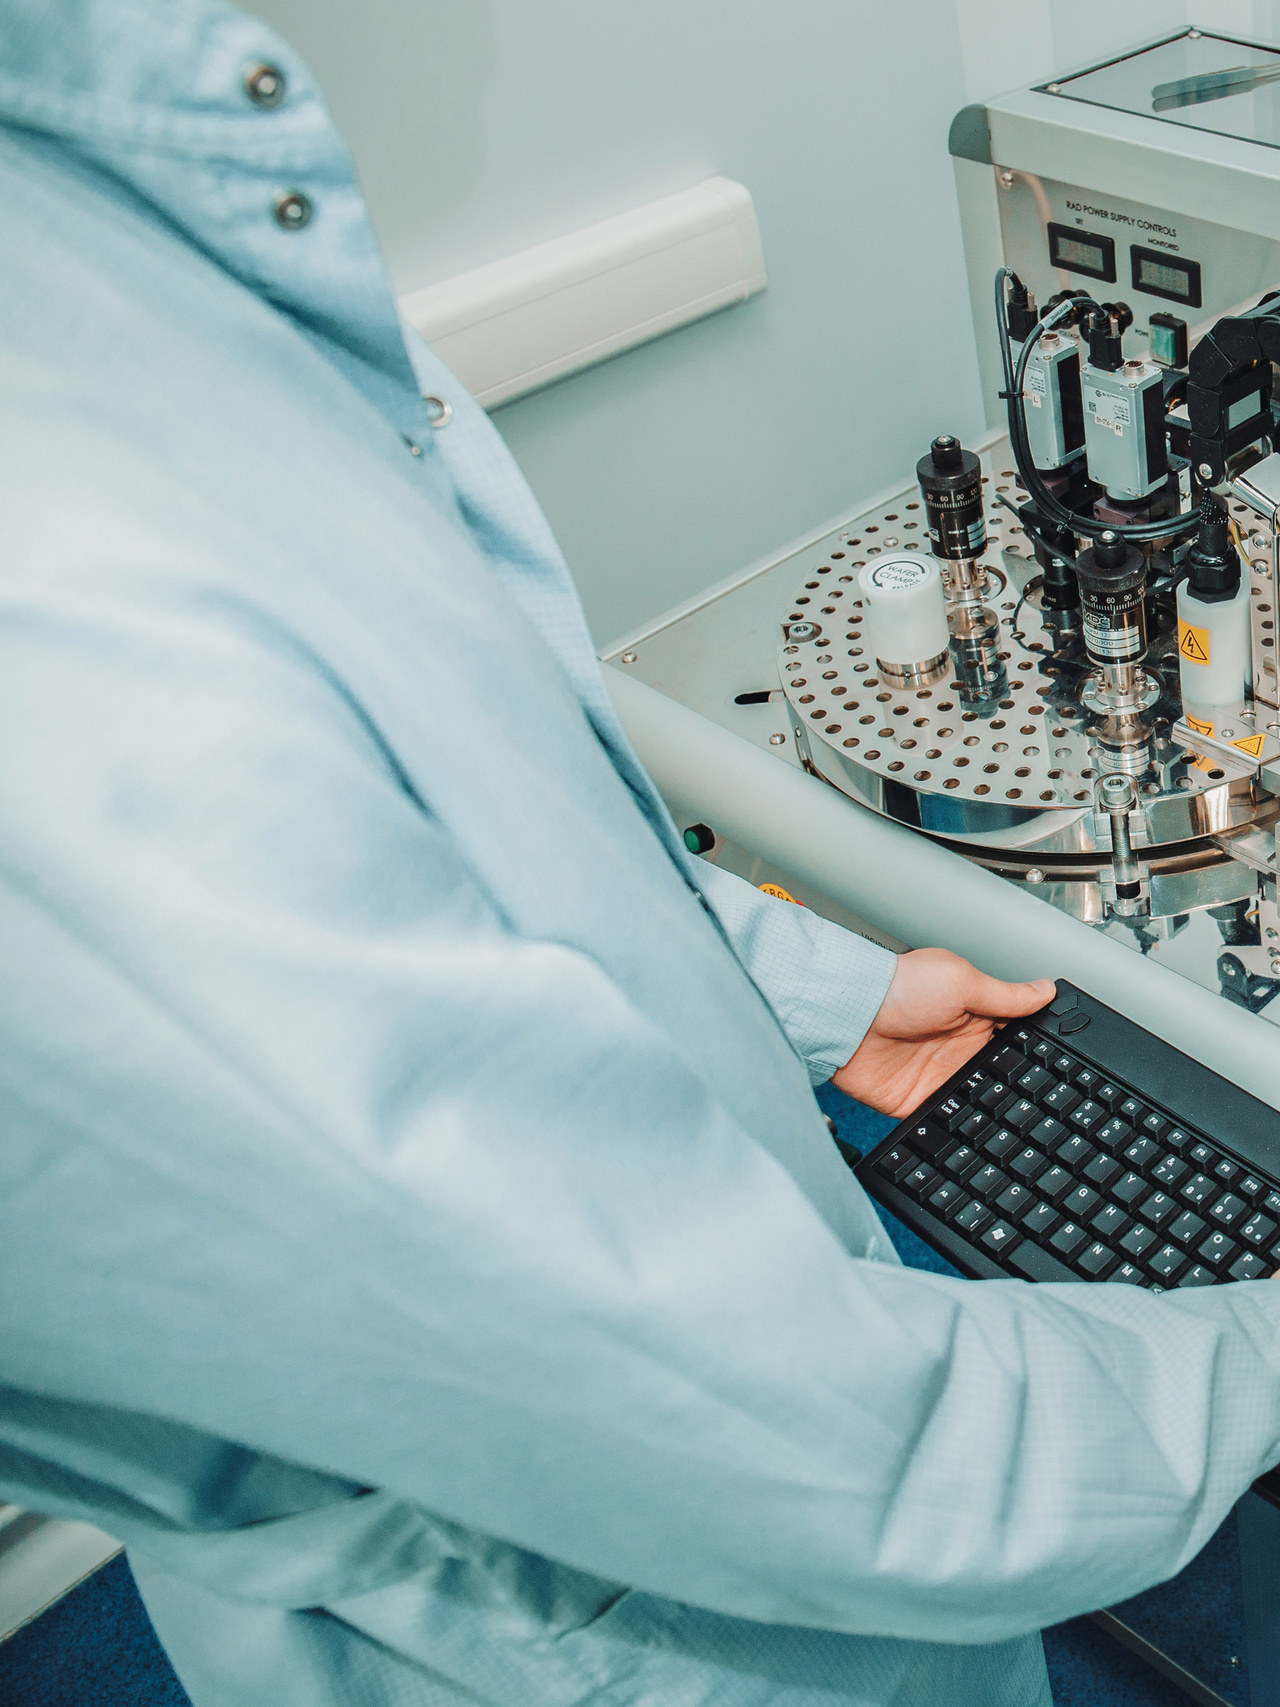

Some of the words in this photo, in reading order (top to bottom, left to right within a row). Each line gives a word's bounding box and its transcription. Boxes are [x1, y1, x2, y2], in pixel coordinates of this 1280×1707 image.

[1066, 200, 1082, 212] RAD
[1083, 205, 1109, 219] POWER
[1110, 212, 1136, 226] SUPPLY
[1136, 219, 1177, 238] CONTROLS
[1147, 237, 1180, 252] MONITORED
[1115, 422, 1122, 433] R
[956, 493, 965, 501] 90
[887, 566, 919, 578] WAFER
[1123, 593, 1133, 602] 90
[1018, 1031, 1029, 1040] Esc
[1039, 1044, 1048, 1052] F1
[1060, 1057, 1069, 1066] F2
[1022, 1076, 1031, 1084] 2
[1081, 1073, 1091, 1081] F3
[993, 1084, 1003, 1093] Q
[1104, 1087, 1113, 1096] F4
[1049, 1093, 1057, 1101] 3
[947, 1098, 960, 1110] Caps
[1019, 1101, 1031, 1111] W
[1126, 1102, 1136, 1110] F5
[973, 1114, 983, 1123] A
[1149, 1117, 1159, 1125] F6
[1044, 1119, 1054, 1128] E
[998, 1132, 1008, 1140] S
[1101, 1129, 1110, 1137] 5
[1172, 1132, 1183, 1141] F7
[1071, 1137, 1081, 1147] R
[890, 1151, 899, 1160] Fn
[958, 1148, 969, 1158] Z
[1024, 1150, 1034, 1158] D
[1129, 1148, 1138, 1156] 6
[1196, 1147, 1206, 1157] F8
[1098, 1155, 1108, 1164] T
[983, 1166, 995, 1177] X
[1050, 1167, 1061, 1176] F
[1157, 1166, 1167, 1174] 7
[1220, 1163, 1231, 1172] F9
[1127, 1174, 1136, 1183] Y
[1245, 1179, 1258, 1190] F10
[1010, 1186, 1020, 1195] C
[1078, 1188, 1089, 1198] G
[1185, 1186, 1195, 1194] 8
[1154, 1193, 1165, 1203] U
[1038, 1204, 1049, 1214] V
[1105, 1206, 1117, 1216] H
[1214, 1205, 1224, 1214] 9
[1064, 1224, 1075, 1234] B
[1134, 1227, 1145, 1236] J
[1213, 1234, 1224, 1244] O
[1092, 1244, 1104, 1255] N
[1163, 1246, 1175, 1257] K
[1243, 1253, 1254, 1262] P
[1121, 1264, 1134, 1277] M
[1193, 1267, 1201, 1278] L
